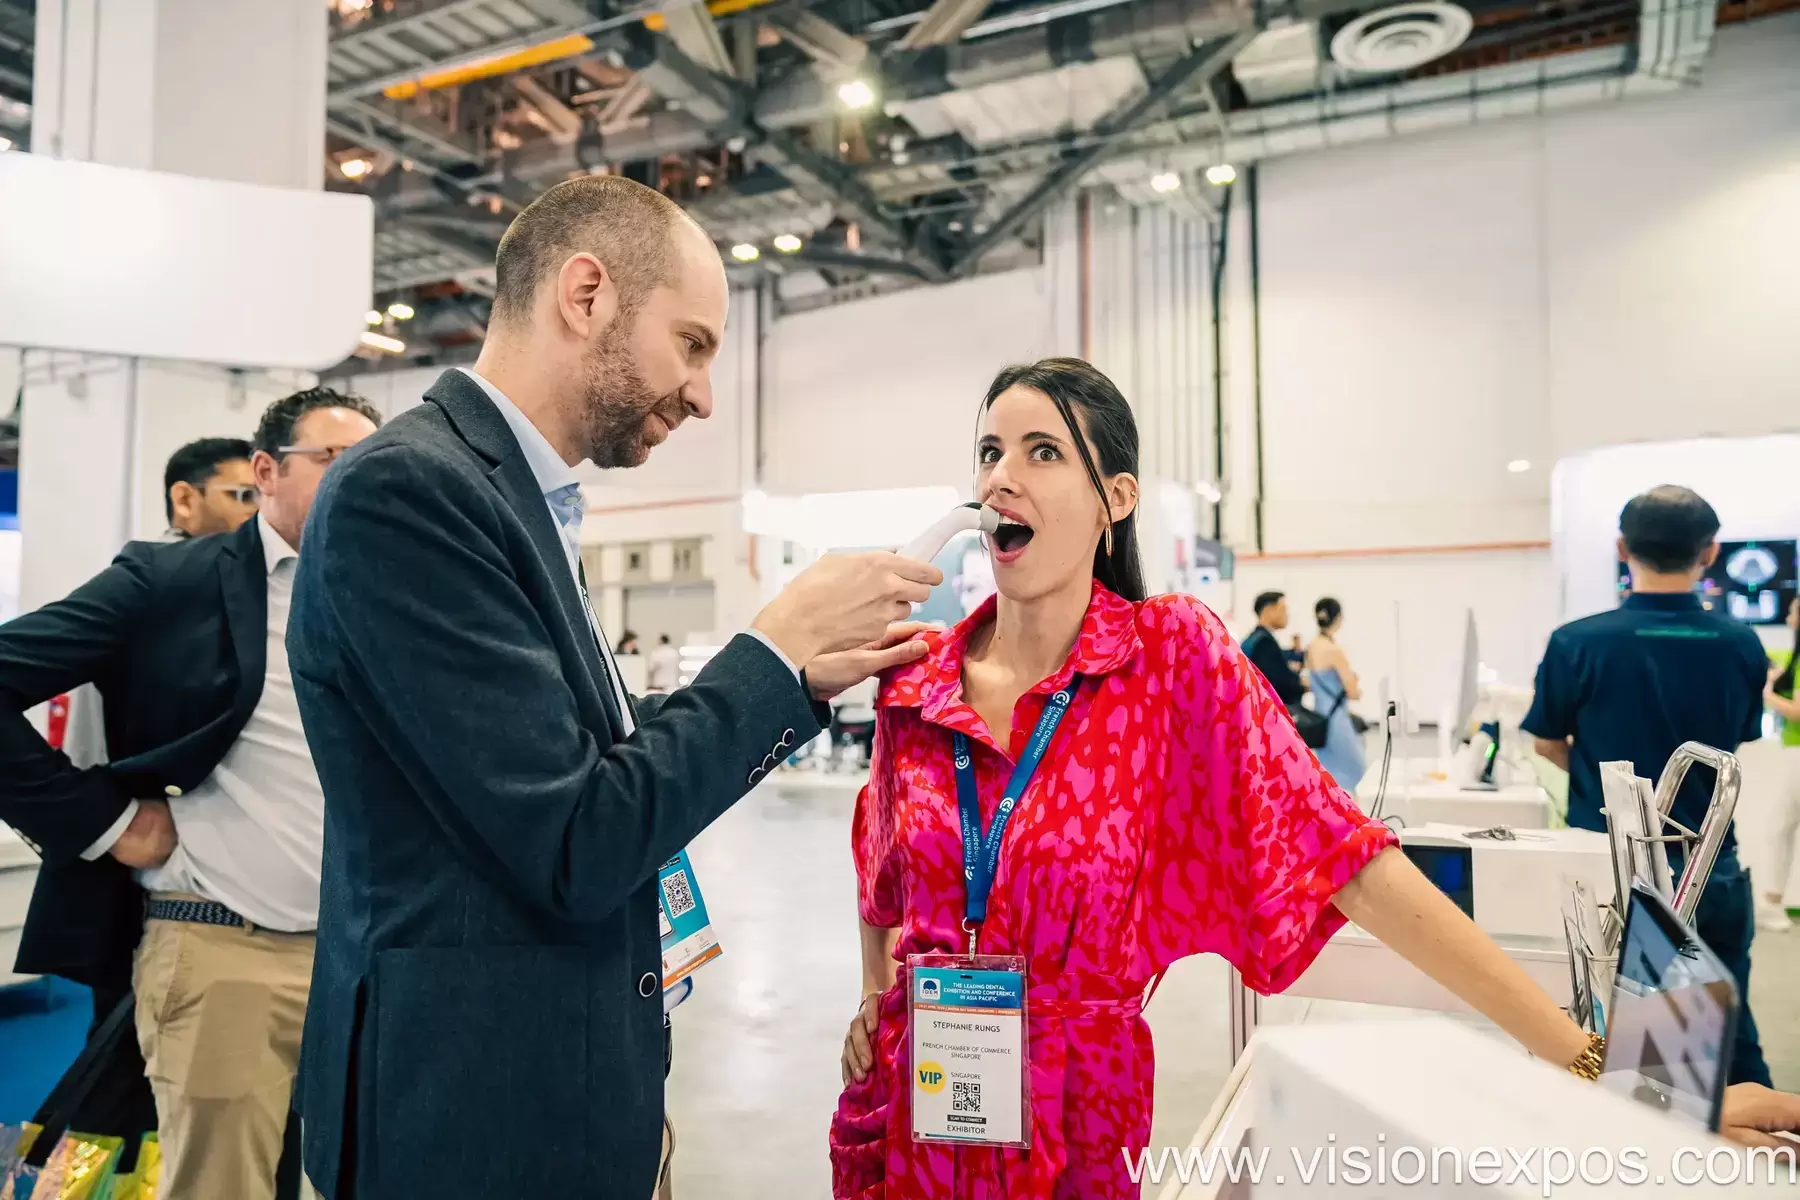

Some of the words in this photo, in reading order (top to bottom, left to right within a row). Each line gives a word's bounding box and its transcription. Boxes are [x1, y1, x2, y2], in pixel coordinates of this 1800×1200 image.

[1035, 706, 1056, 737] Singapore
[1048, 708, 1064, 729] French
[1032, 730, 1052, 759] Chamber
[962, 808, 970, 836] Chamber
[985, 814, 1002, 849] Singapore
[995, 815, 1007, 840] French
[988, 841, 999, 874] Chamber
[982, 989, 1016, 997] CONFERENCE
[933, 1020, 972, 1031] STEPHANIE
[922, 1042, 943, 1050] FRENCH
[944, 1044, 970, 1052] CHAMBER
[980, 1046, 1012, 1054] COMMERCE
[919, 1070, 943, 1085] VIP
[950, 1072, 981, 1080] SINGAPORE
[946, 1124, 986, 1134] EXHIBITOR
